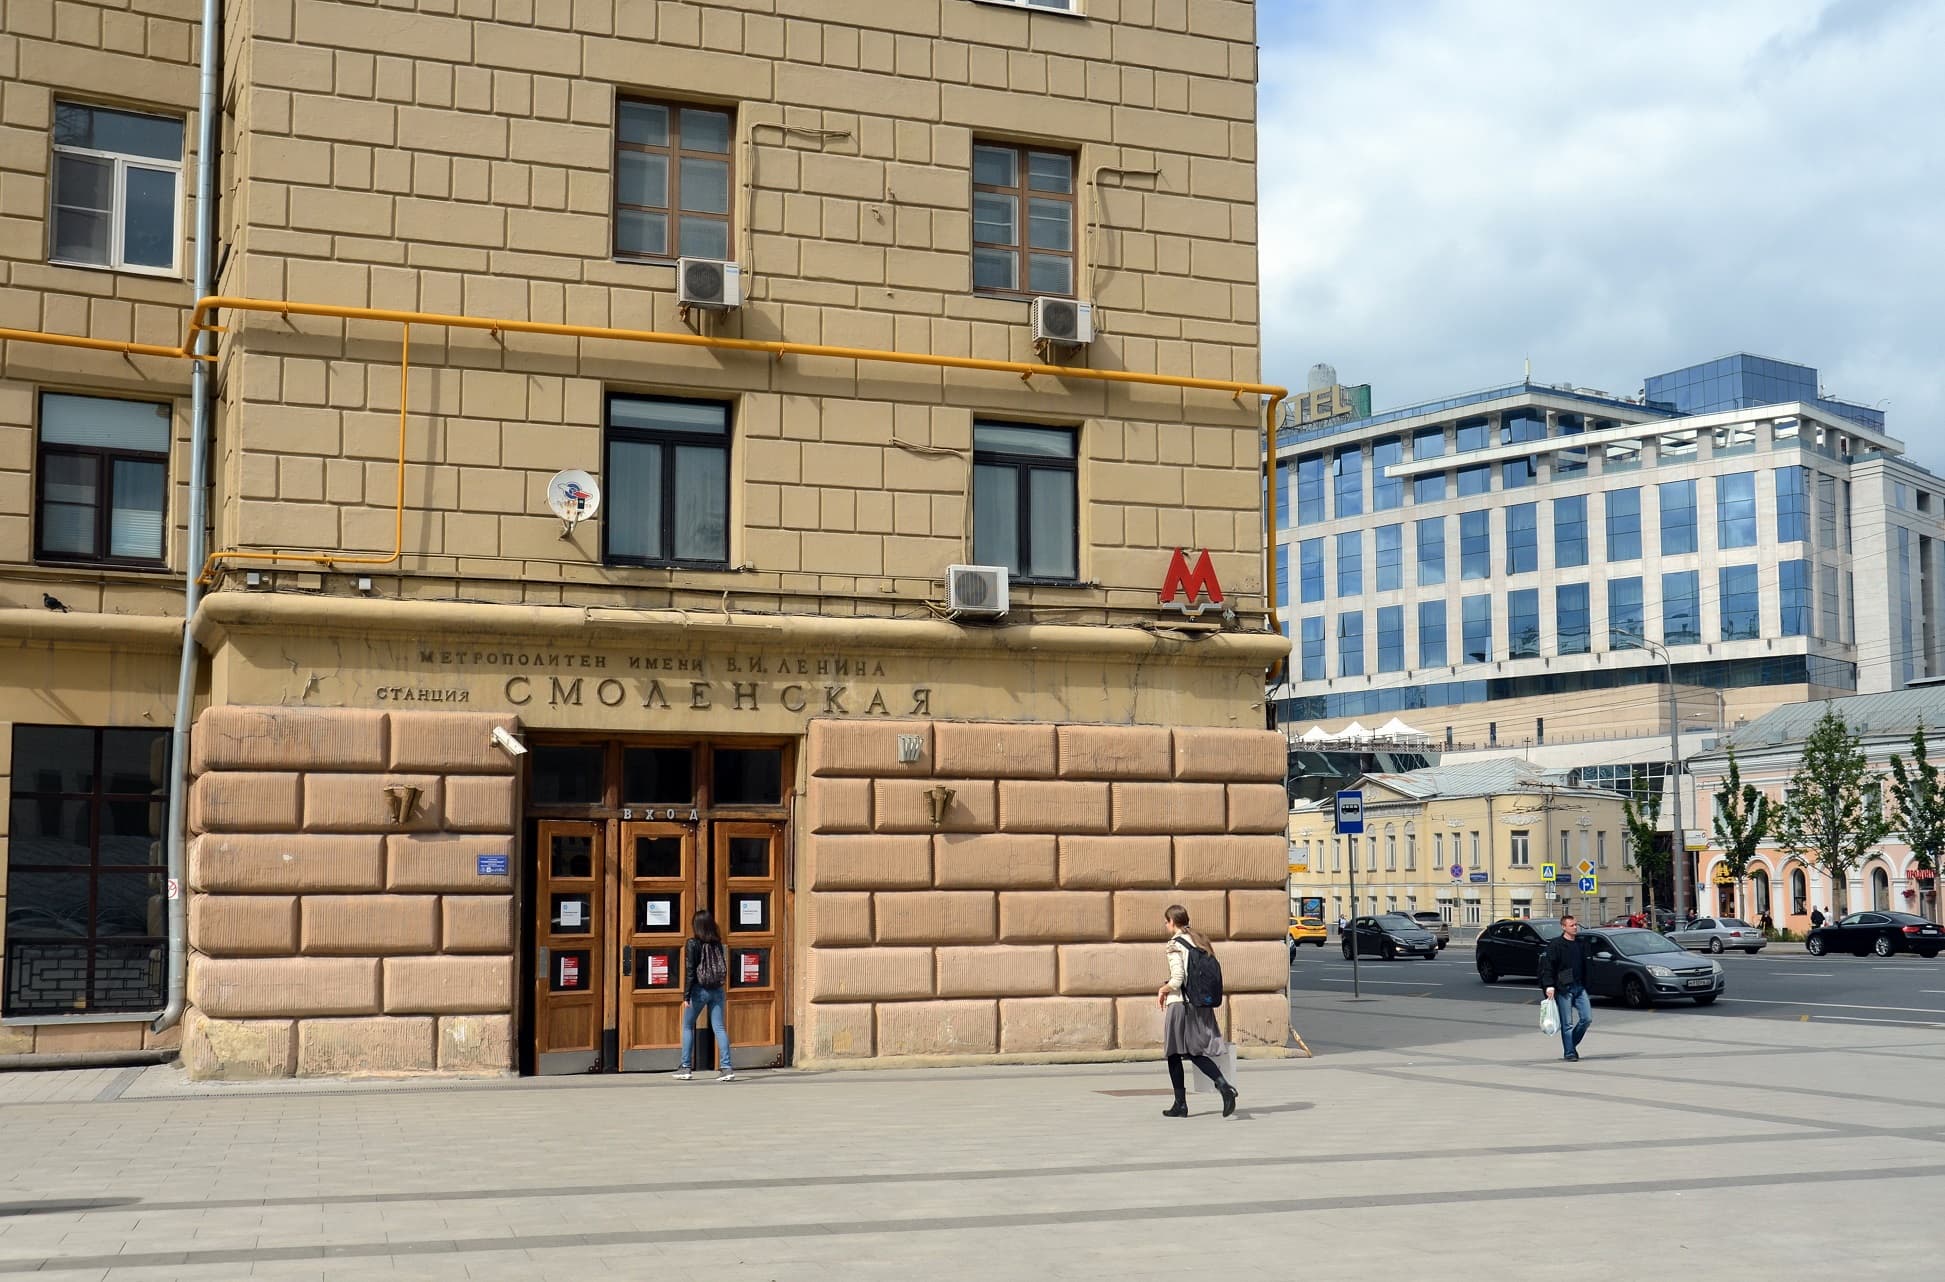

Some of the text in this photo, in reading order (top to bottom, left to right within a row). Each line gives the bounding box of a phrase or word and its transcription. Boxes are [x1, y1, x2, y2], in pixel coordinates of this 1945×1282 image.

[1161, 547, 1225, 604] М
[420, 651, 607, 668] МЕТРОПОЛИТЕН
[629, 656, 704, 671] ИМЕНИ
[777, 658, 885, 676] ЛЕНИНА
[376, 676, 931, 715] СТАНЦИЯ СМОЛЕНСКАЯ
[623, 808, 698, 820] ВХОД
